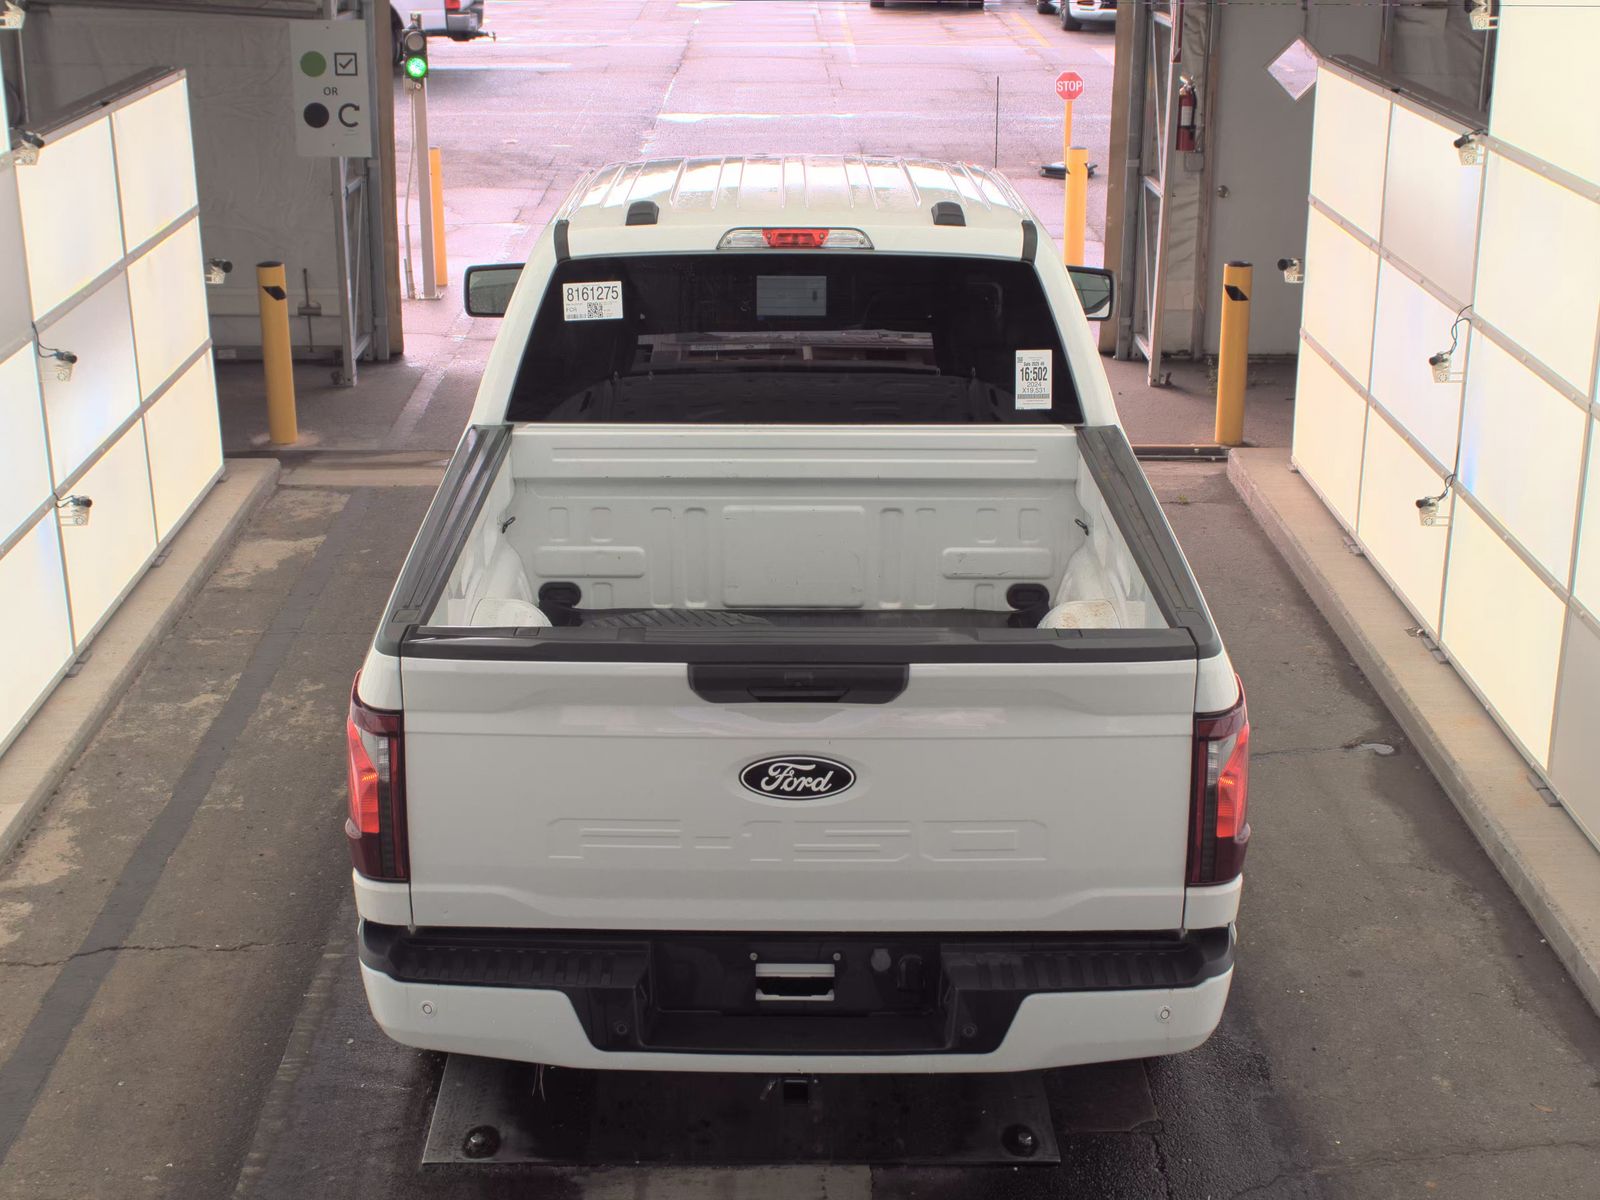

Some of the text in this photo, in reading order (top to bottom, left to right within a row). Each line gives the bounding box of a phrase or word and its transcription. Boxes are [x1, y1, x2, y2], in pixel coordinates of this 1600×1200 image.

[323, 86, 339, 96] OR
[1057, 80, 1082, 92] STOP
[566, 286, 619, 301] 8161275
[1020, 366, 1048, 381] 16:502
[760, 762, 834, 792] Ford
[547, 818, 1048, 864] F-150
